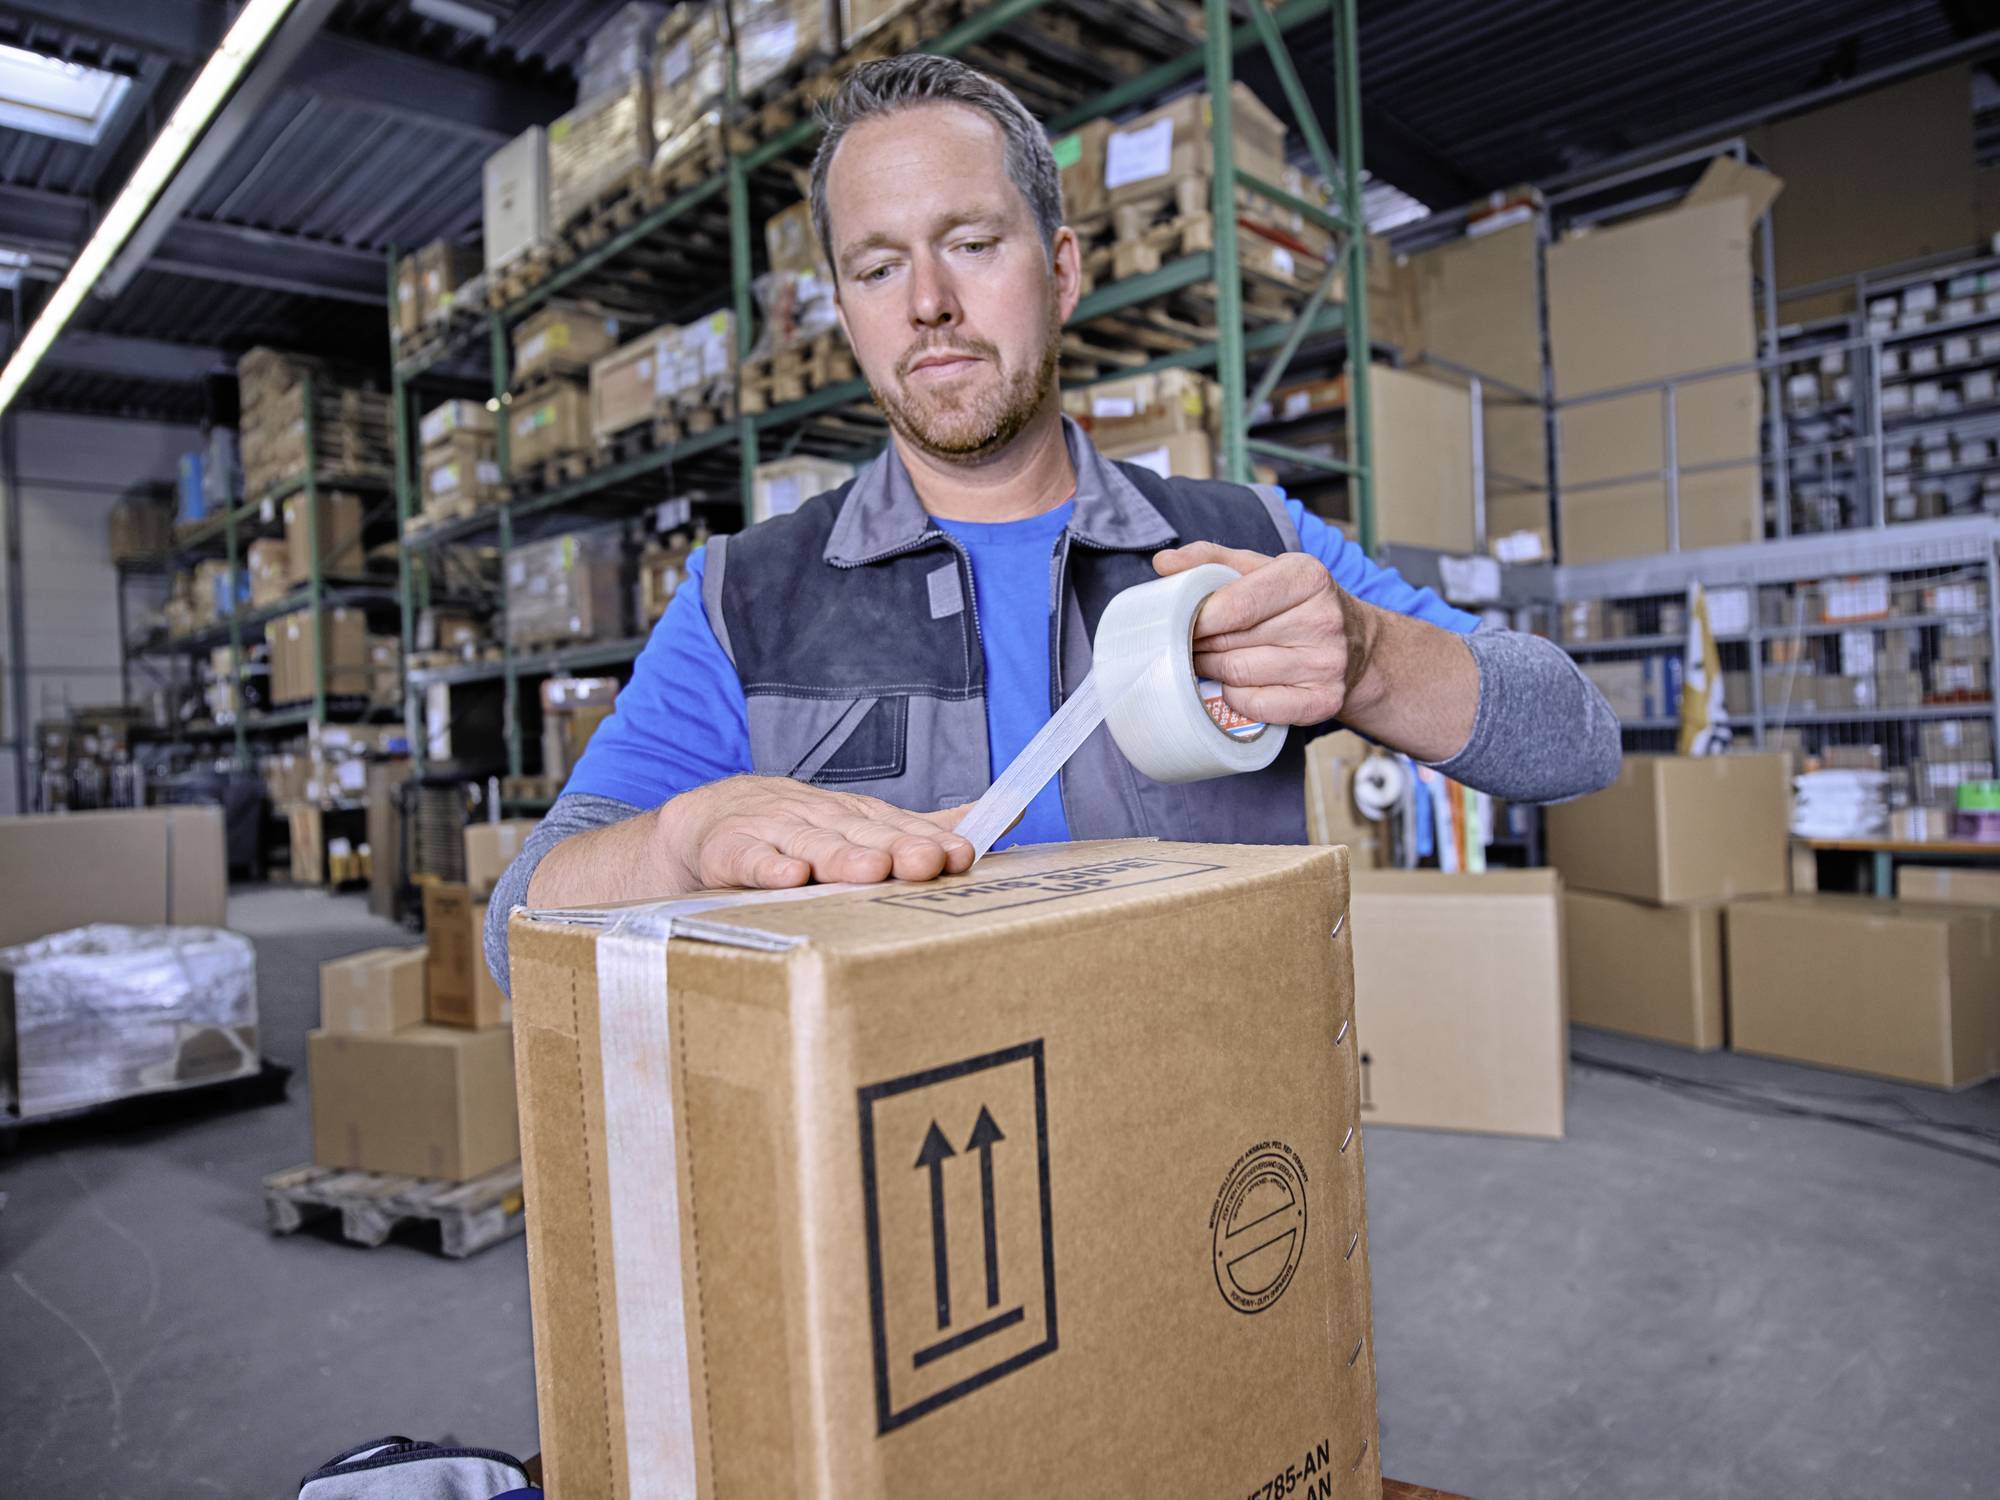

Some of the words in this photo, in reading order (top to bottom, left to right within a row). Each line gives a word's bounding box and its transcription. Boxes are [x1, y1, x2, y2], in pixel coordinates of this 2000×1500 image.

[905, 881, 1041, 901] THIS
[1041, 861, 1160, 880] SIDE
[1038, 878, 1111, 892] UP
[1292, 1153, 1309, 1183] GERMANY
